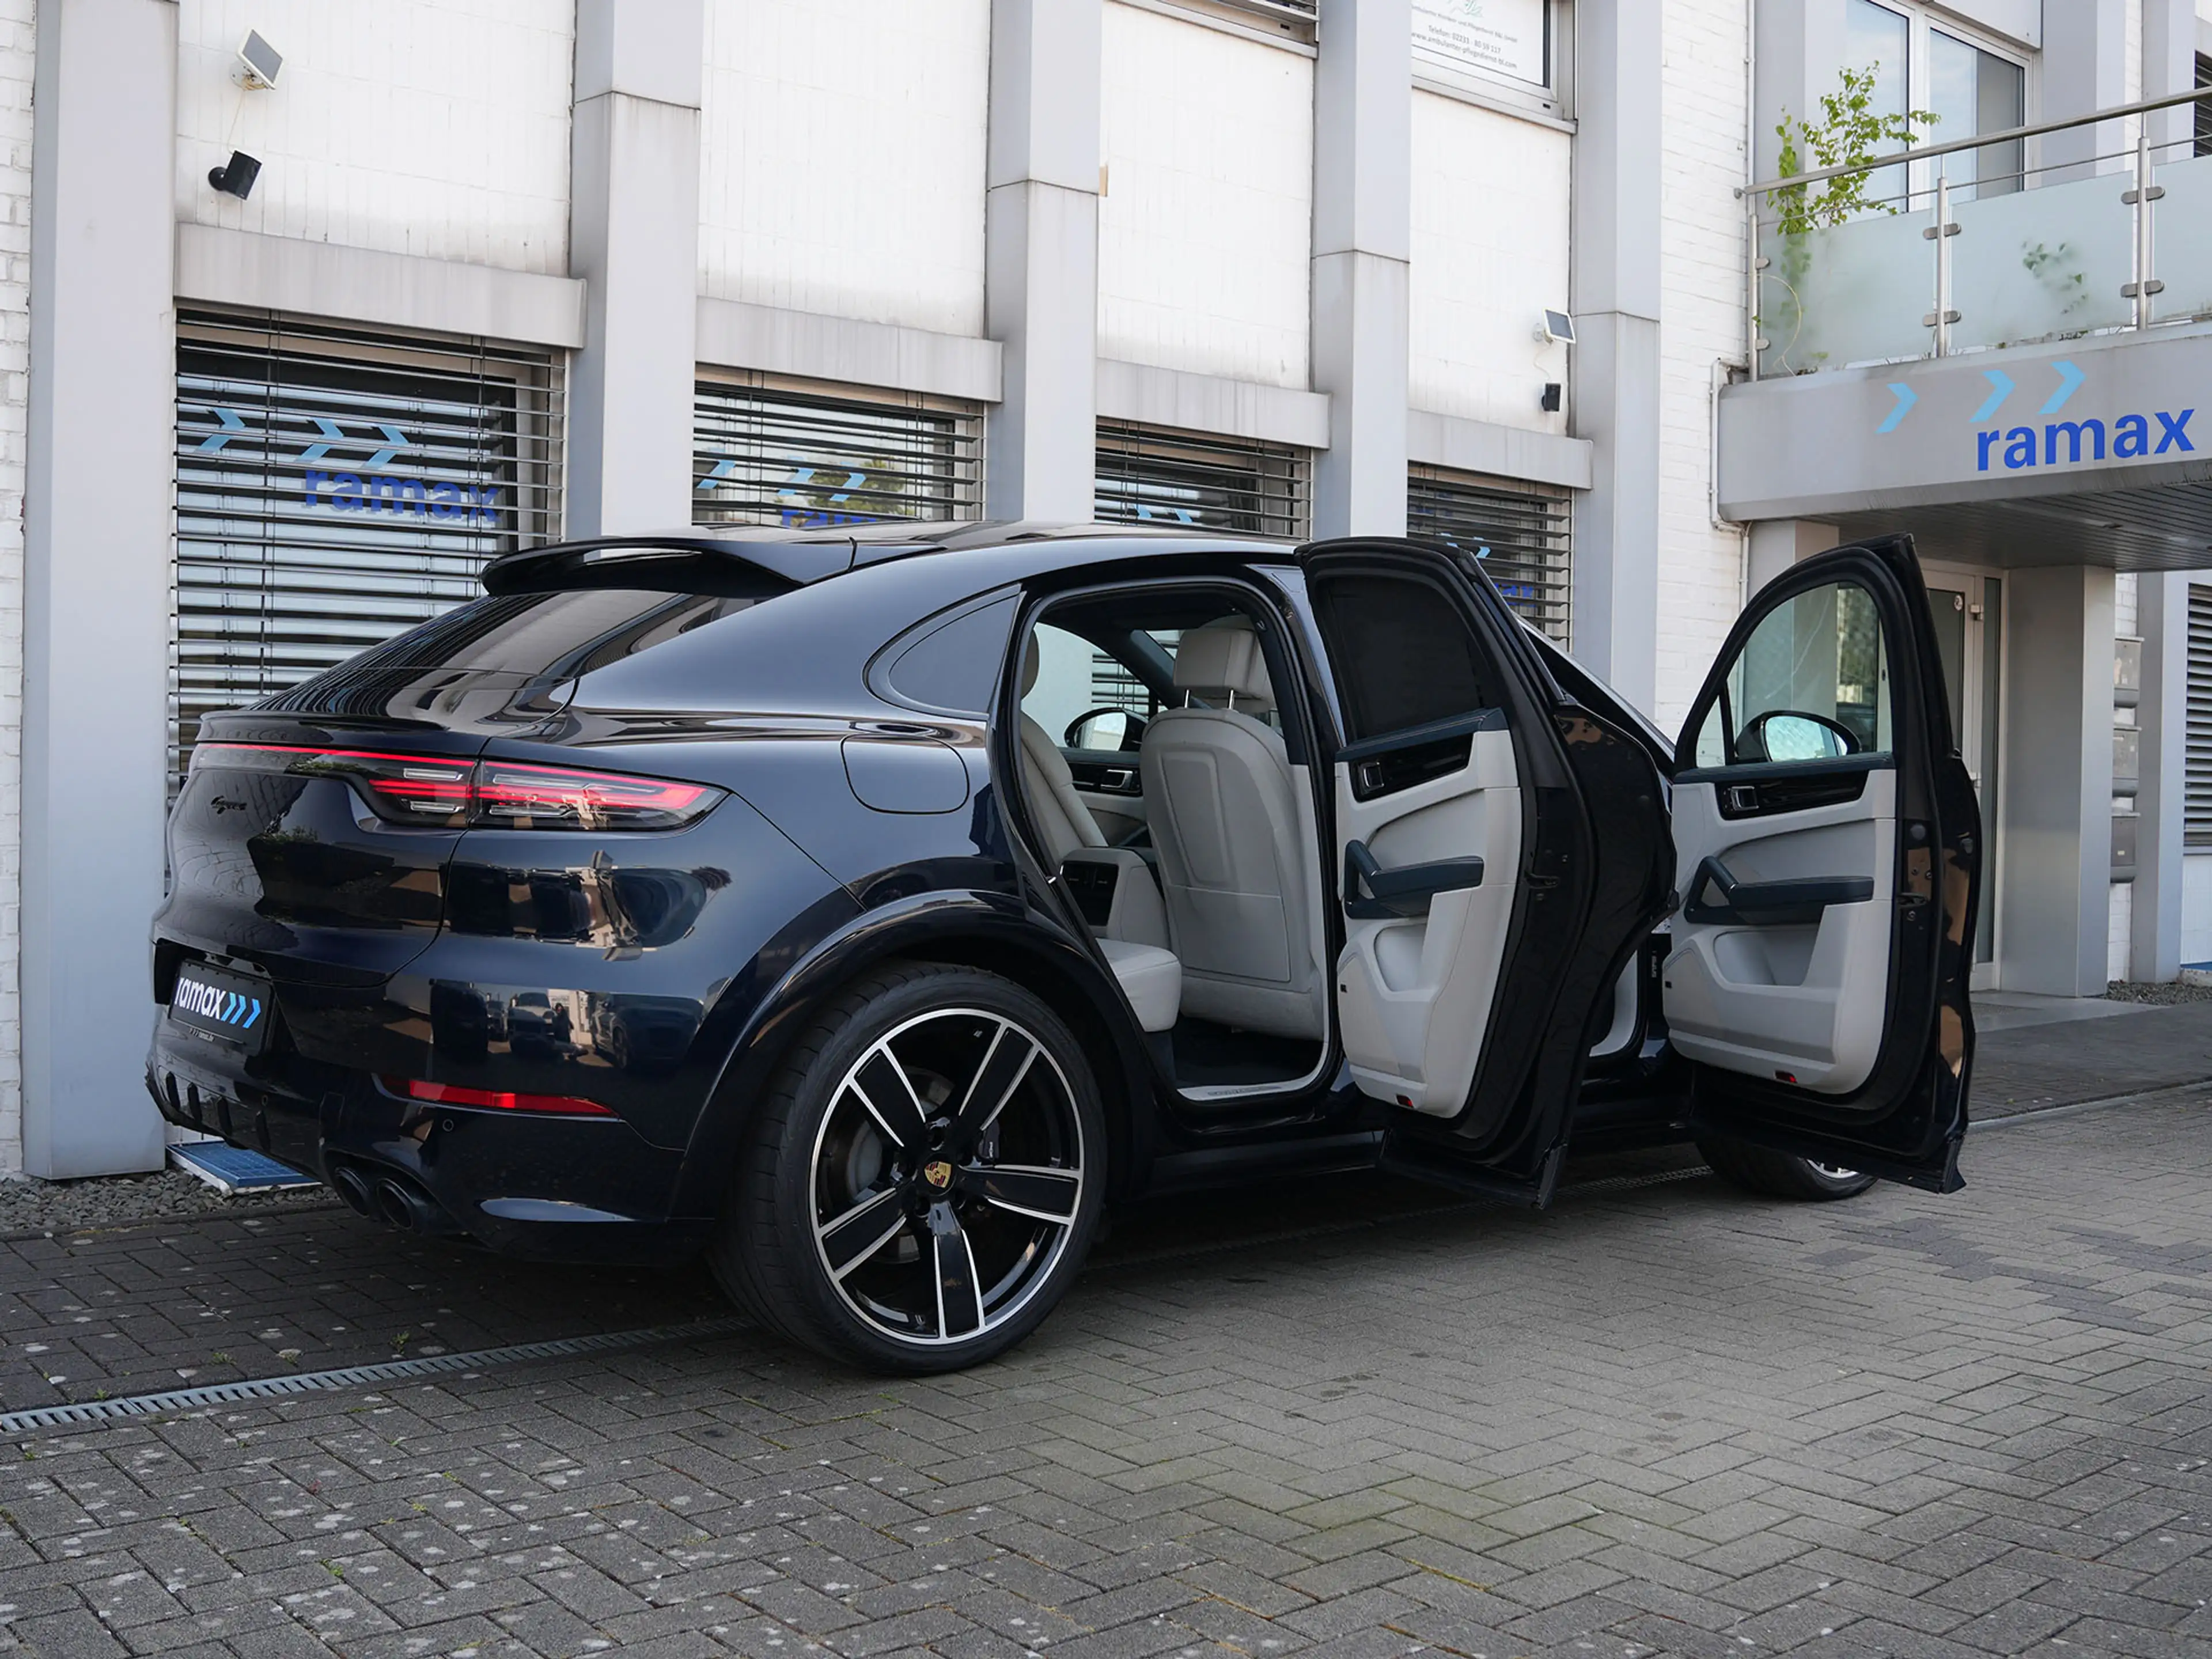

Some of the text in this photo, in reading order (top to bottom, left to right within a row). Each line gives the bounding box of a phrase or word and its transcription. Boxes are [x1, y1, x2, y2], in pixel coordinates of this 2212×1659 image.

[1978, 409, 2195, 471] ramax
[306, 469, 502, 522] ramax
[174, 977, 226, 1020] ramax
